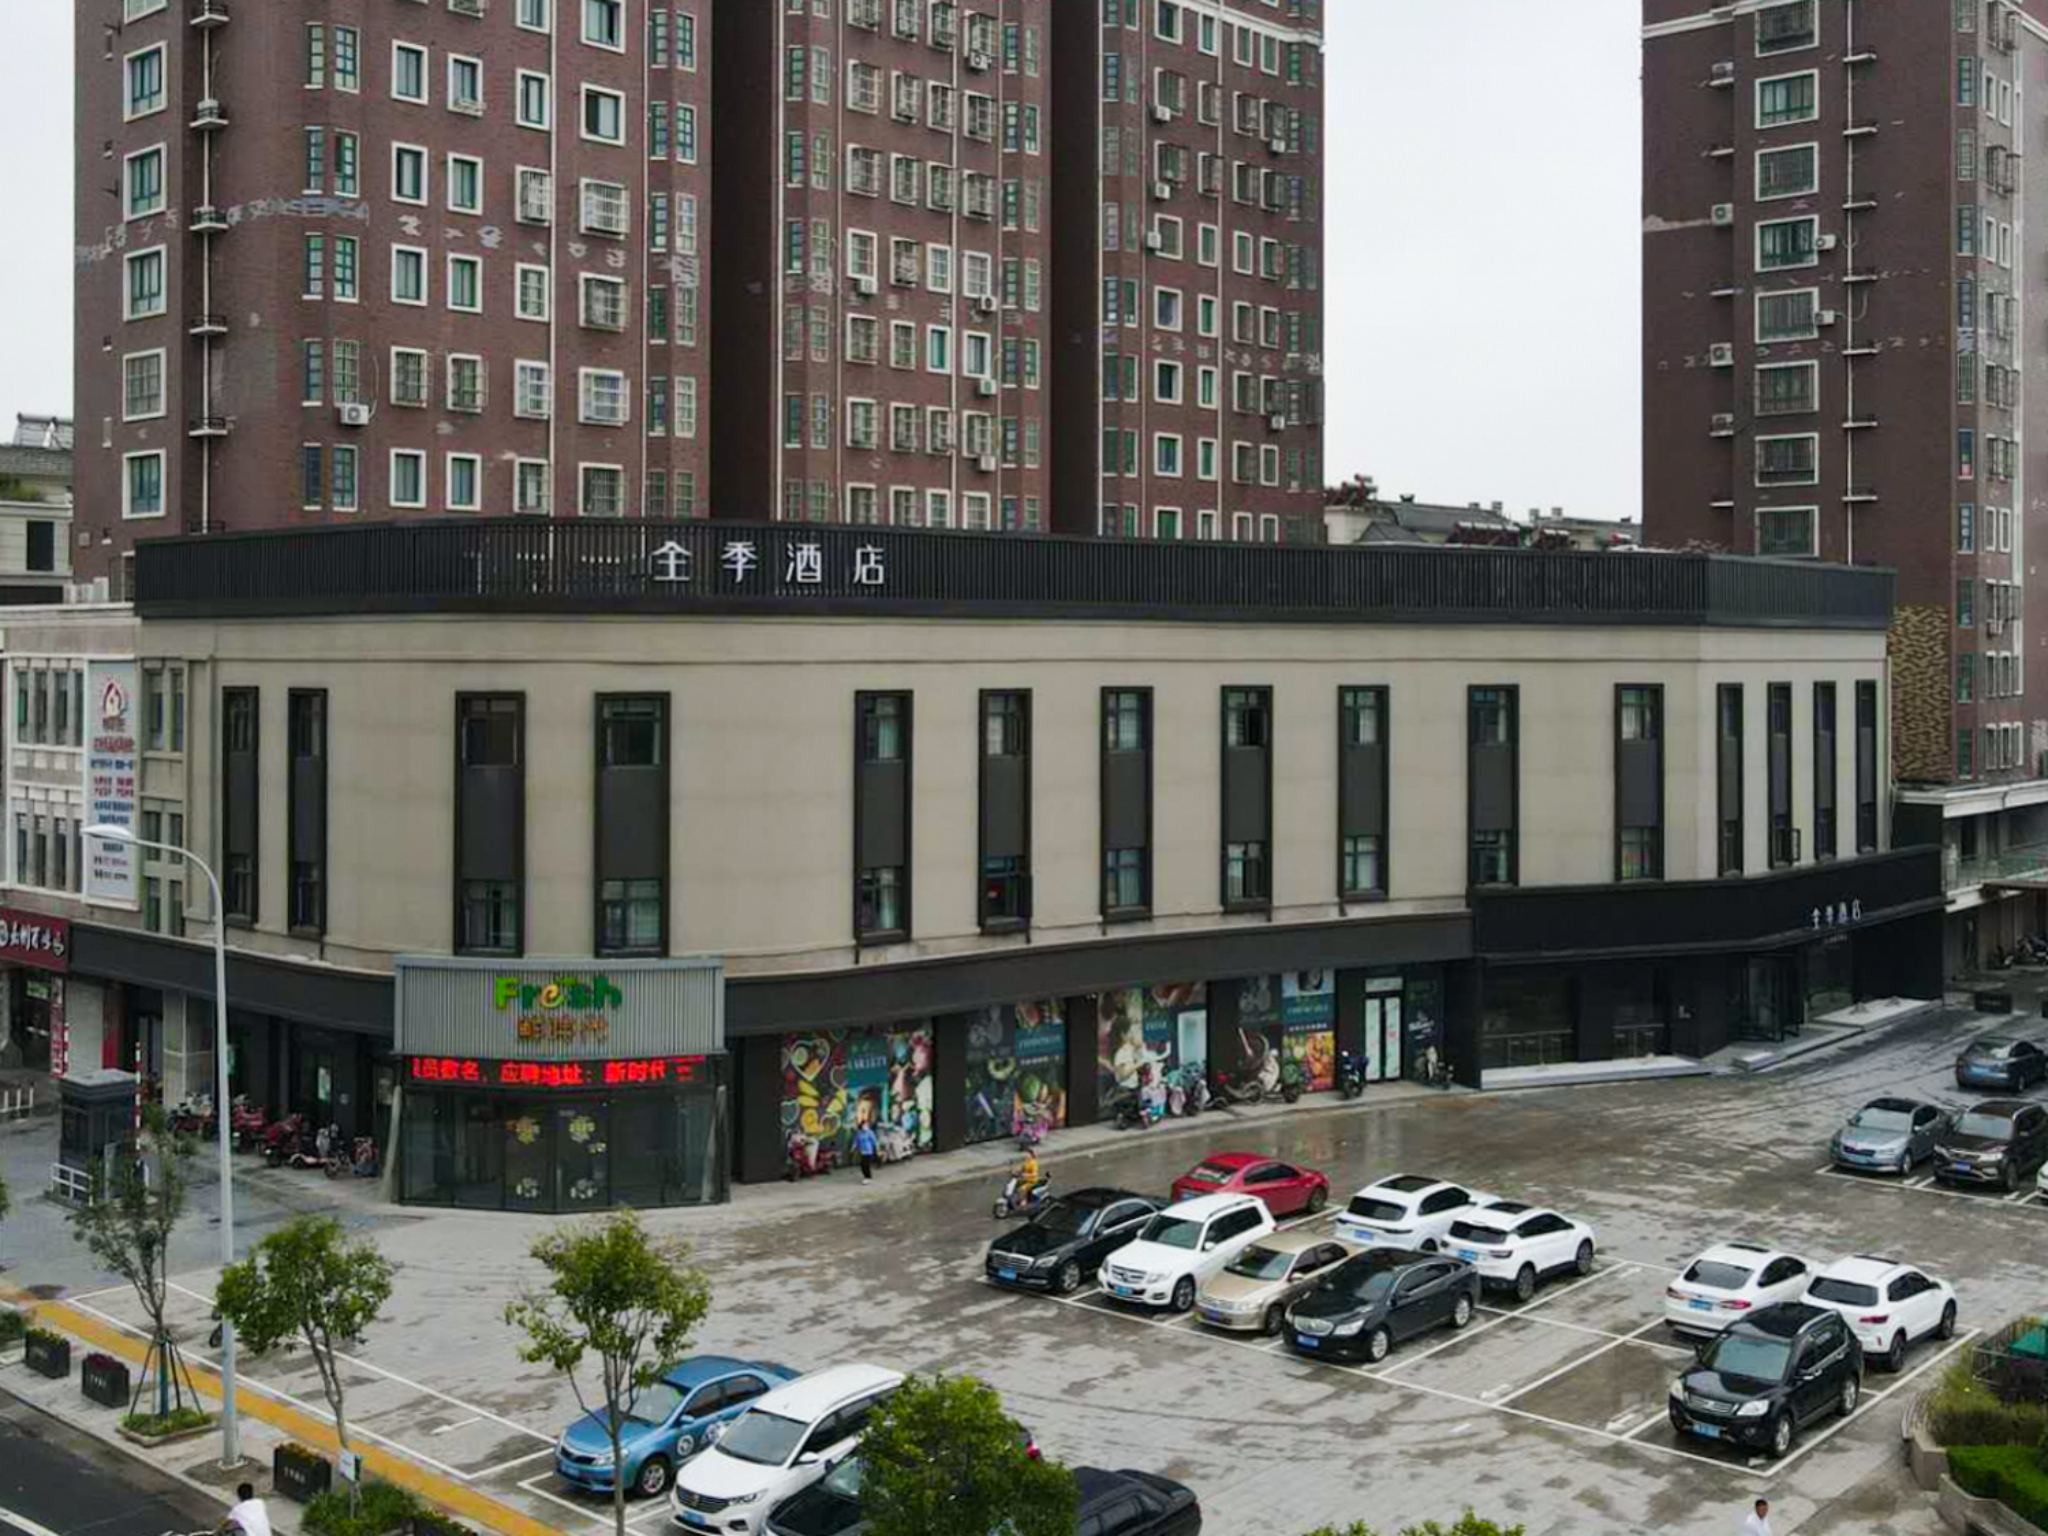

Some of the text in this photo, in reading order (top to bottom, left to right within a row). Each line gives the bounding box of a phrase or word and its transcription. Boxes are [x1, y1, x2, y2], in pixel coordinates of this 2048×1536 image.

[651, 540, 885, 585] 全季酒店
[495, 975, 622, 1010] Fresh
